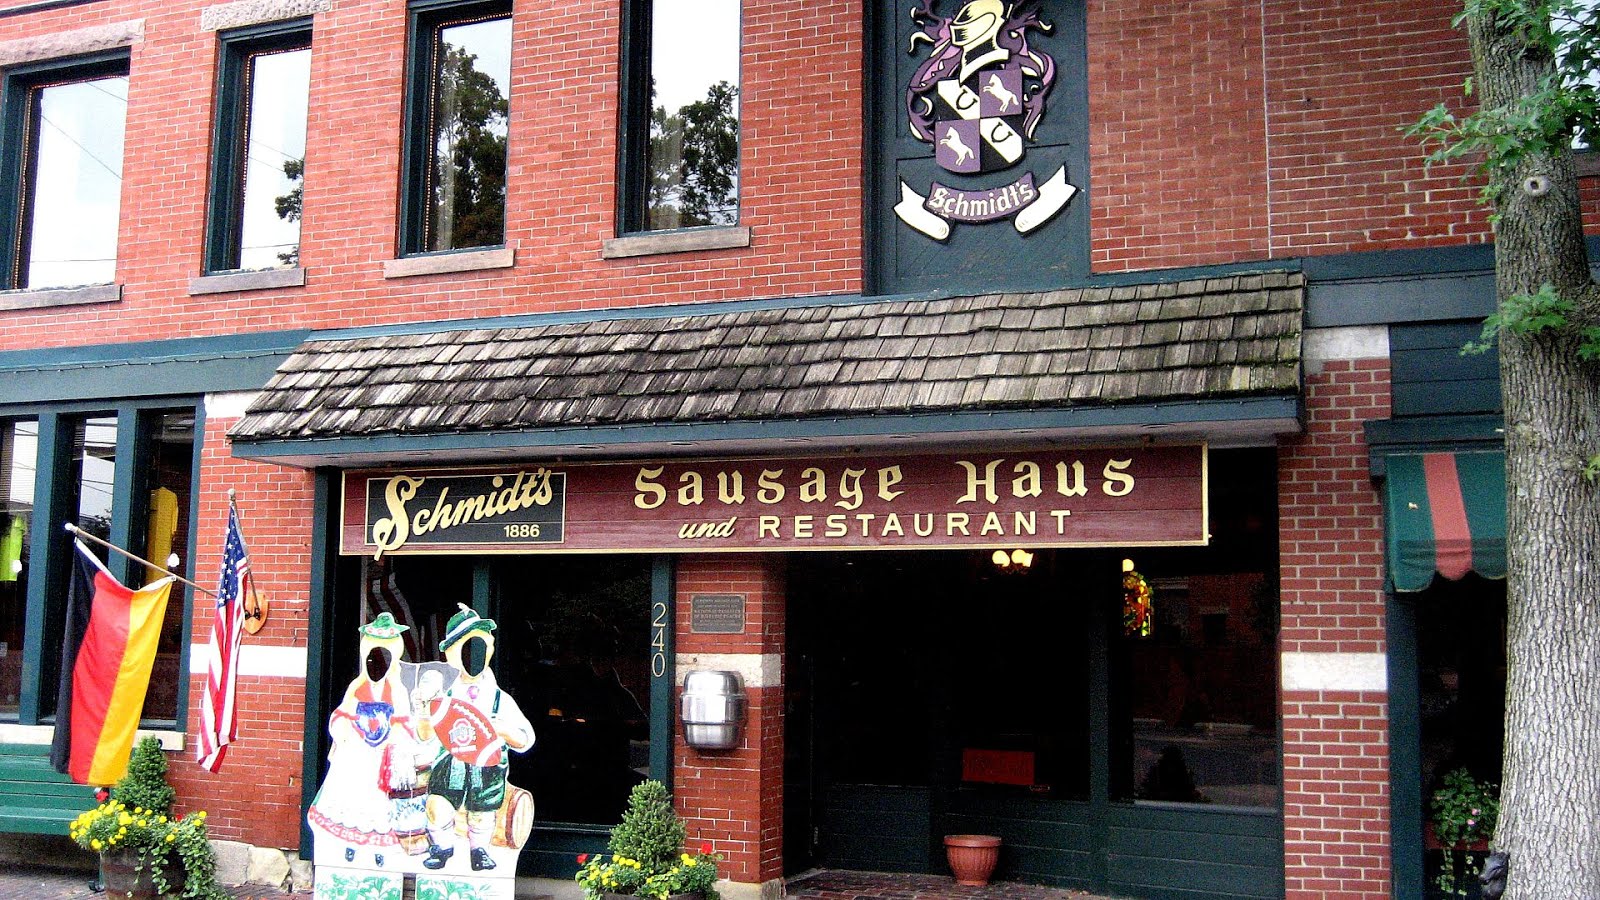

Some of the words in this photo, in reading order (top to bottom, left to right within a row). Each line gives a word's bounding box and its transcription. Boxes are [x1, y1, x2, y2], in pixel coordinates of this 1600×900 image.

[930, 183, 1034, 217] Schmidt's
[634, 465, 905, 510] Sausage
[955, 458, 1135, 504] Haus
[372, 468, 553, 561] Schmidt's
[503, 524, 540, 538] 1886
[678, 516, 738, 539] und
[759, 509, 1071, 538] RESTAURANT
[651, 602, 667, 677] 240
